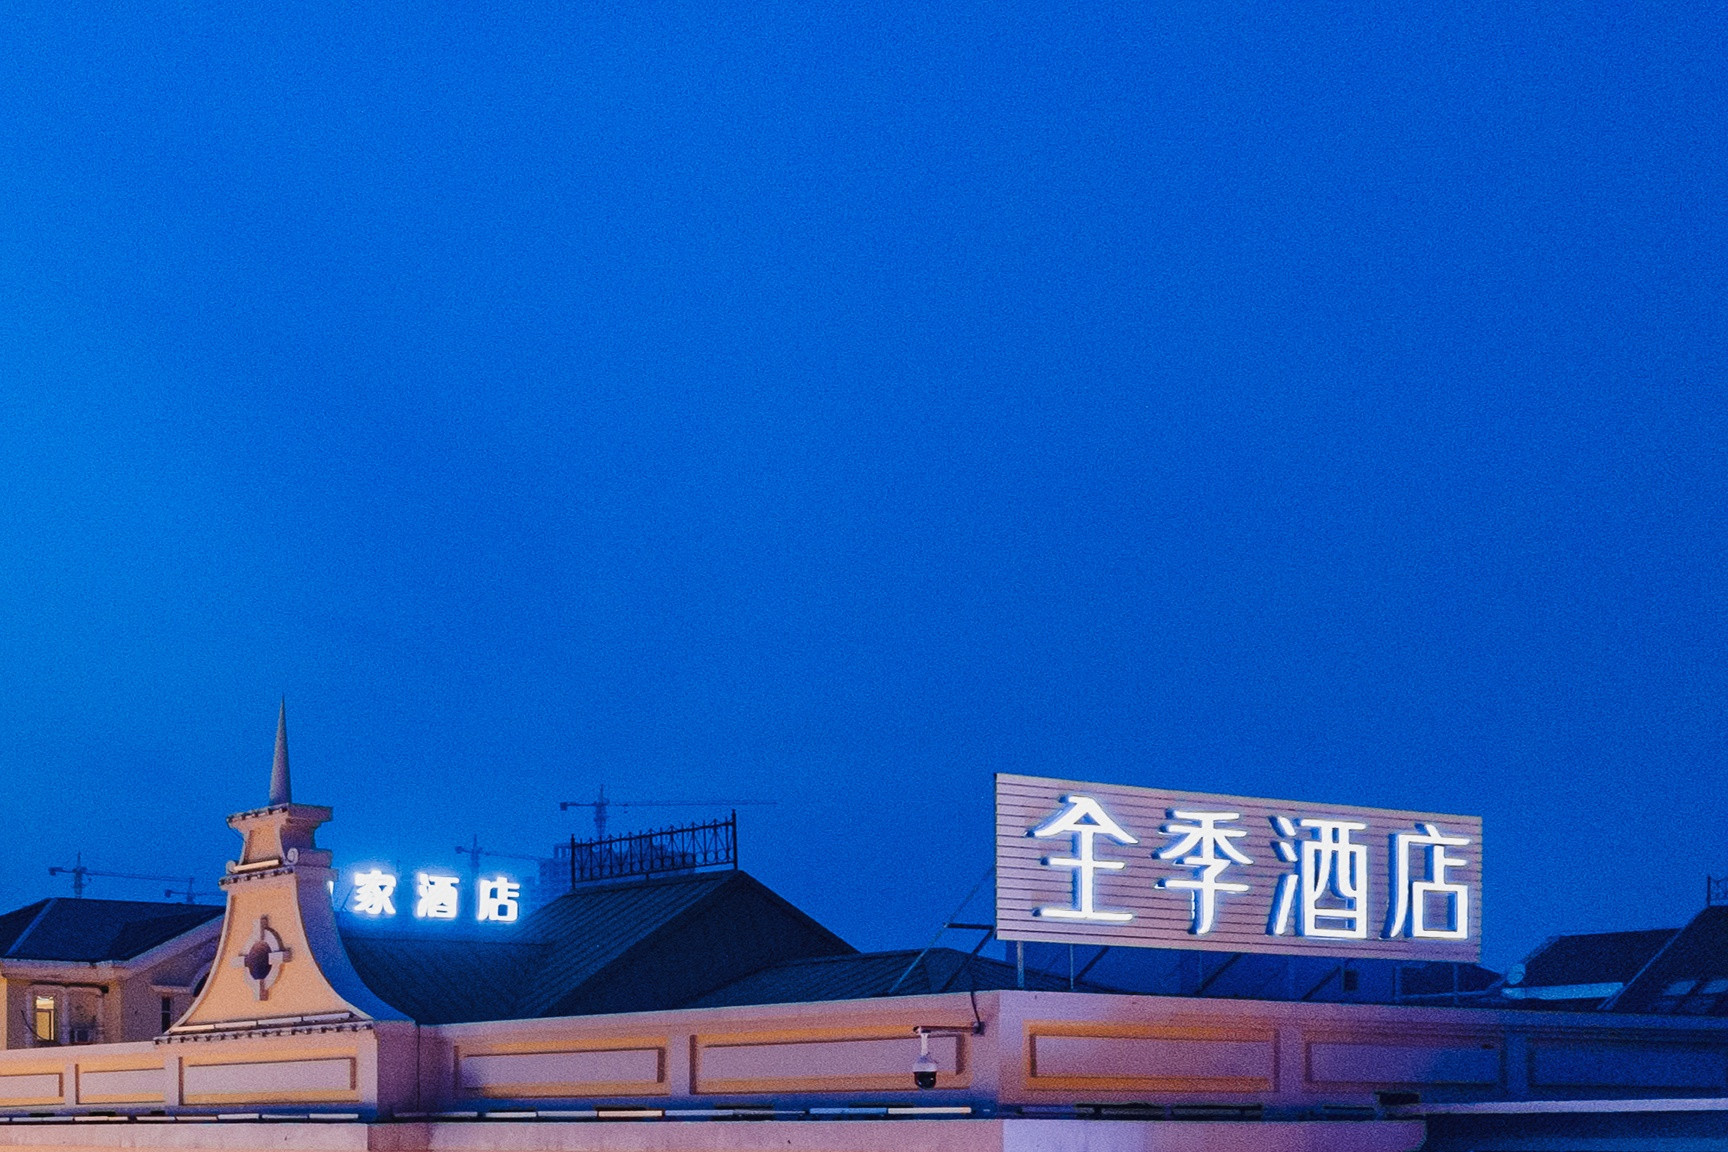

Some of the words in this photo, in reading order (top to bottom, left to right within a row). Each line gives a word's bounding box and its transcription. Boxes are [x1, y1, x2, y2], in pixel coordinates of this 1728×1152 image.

[328, 870, 521, 923] 家酒店
[1027, 796, 1470, 940] 全季酒店
